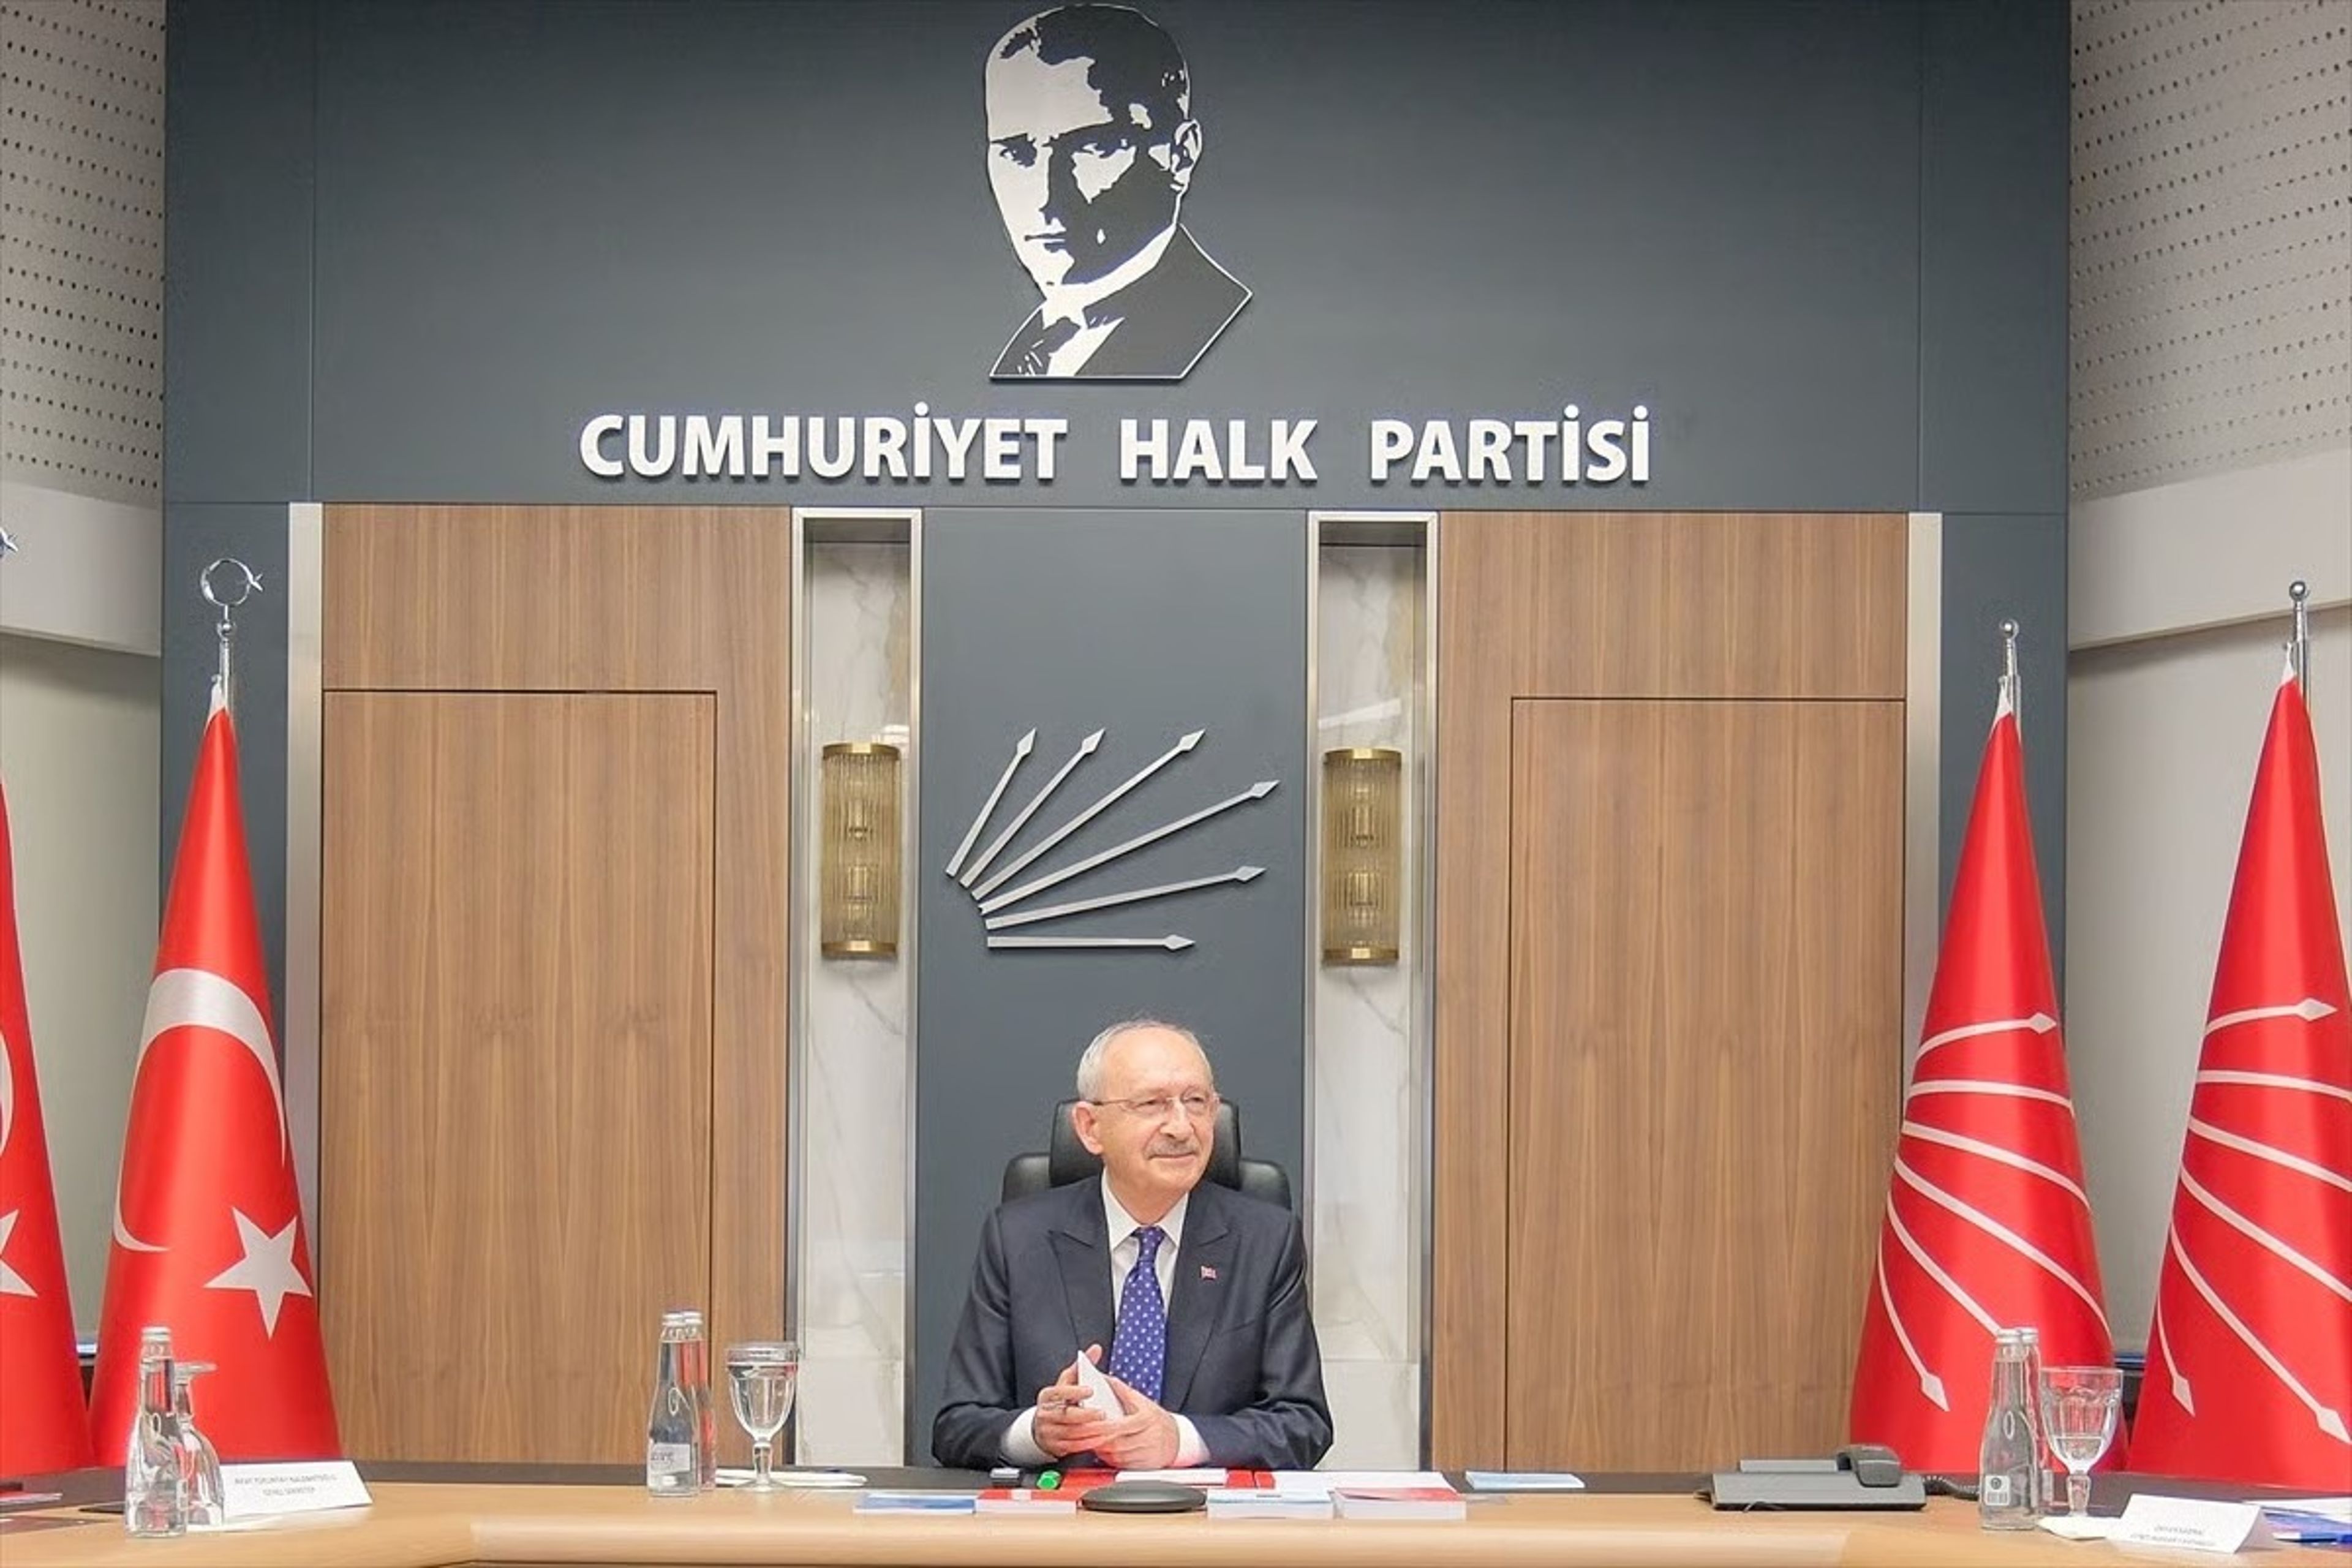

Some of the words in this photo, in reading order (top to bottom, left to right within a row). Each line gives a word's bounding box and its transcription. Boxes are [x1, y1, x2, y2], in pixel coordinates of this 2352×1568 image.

[579, 401, 1069, 480] CUMHURİYET
[1120, 418, 1319, 481] HALK
[1370, 403, 1651, 483] PARTİSİ
